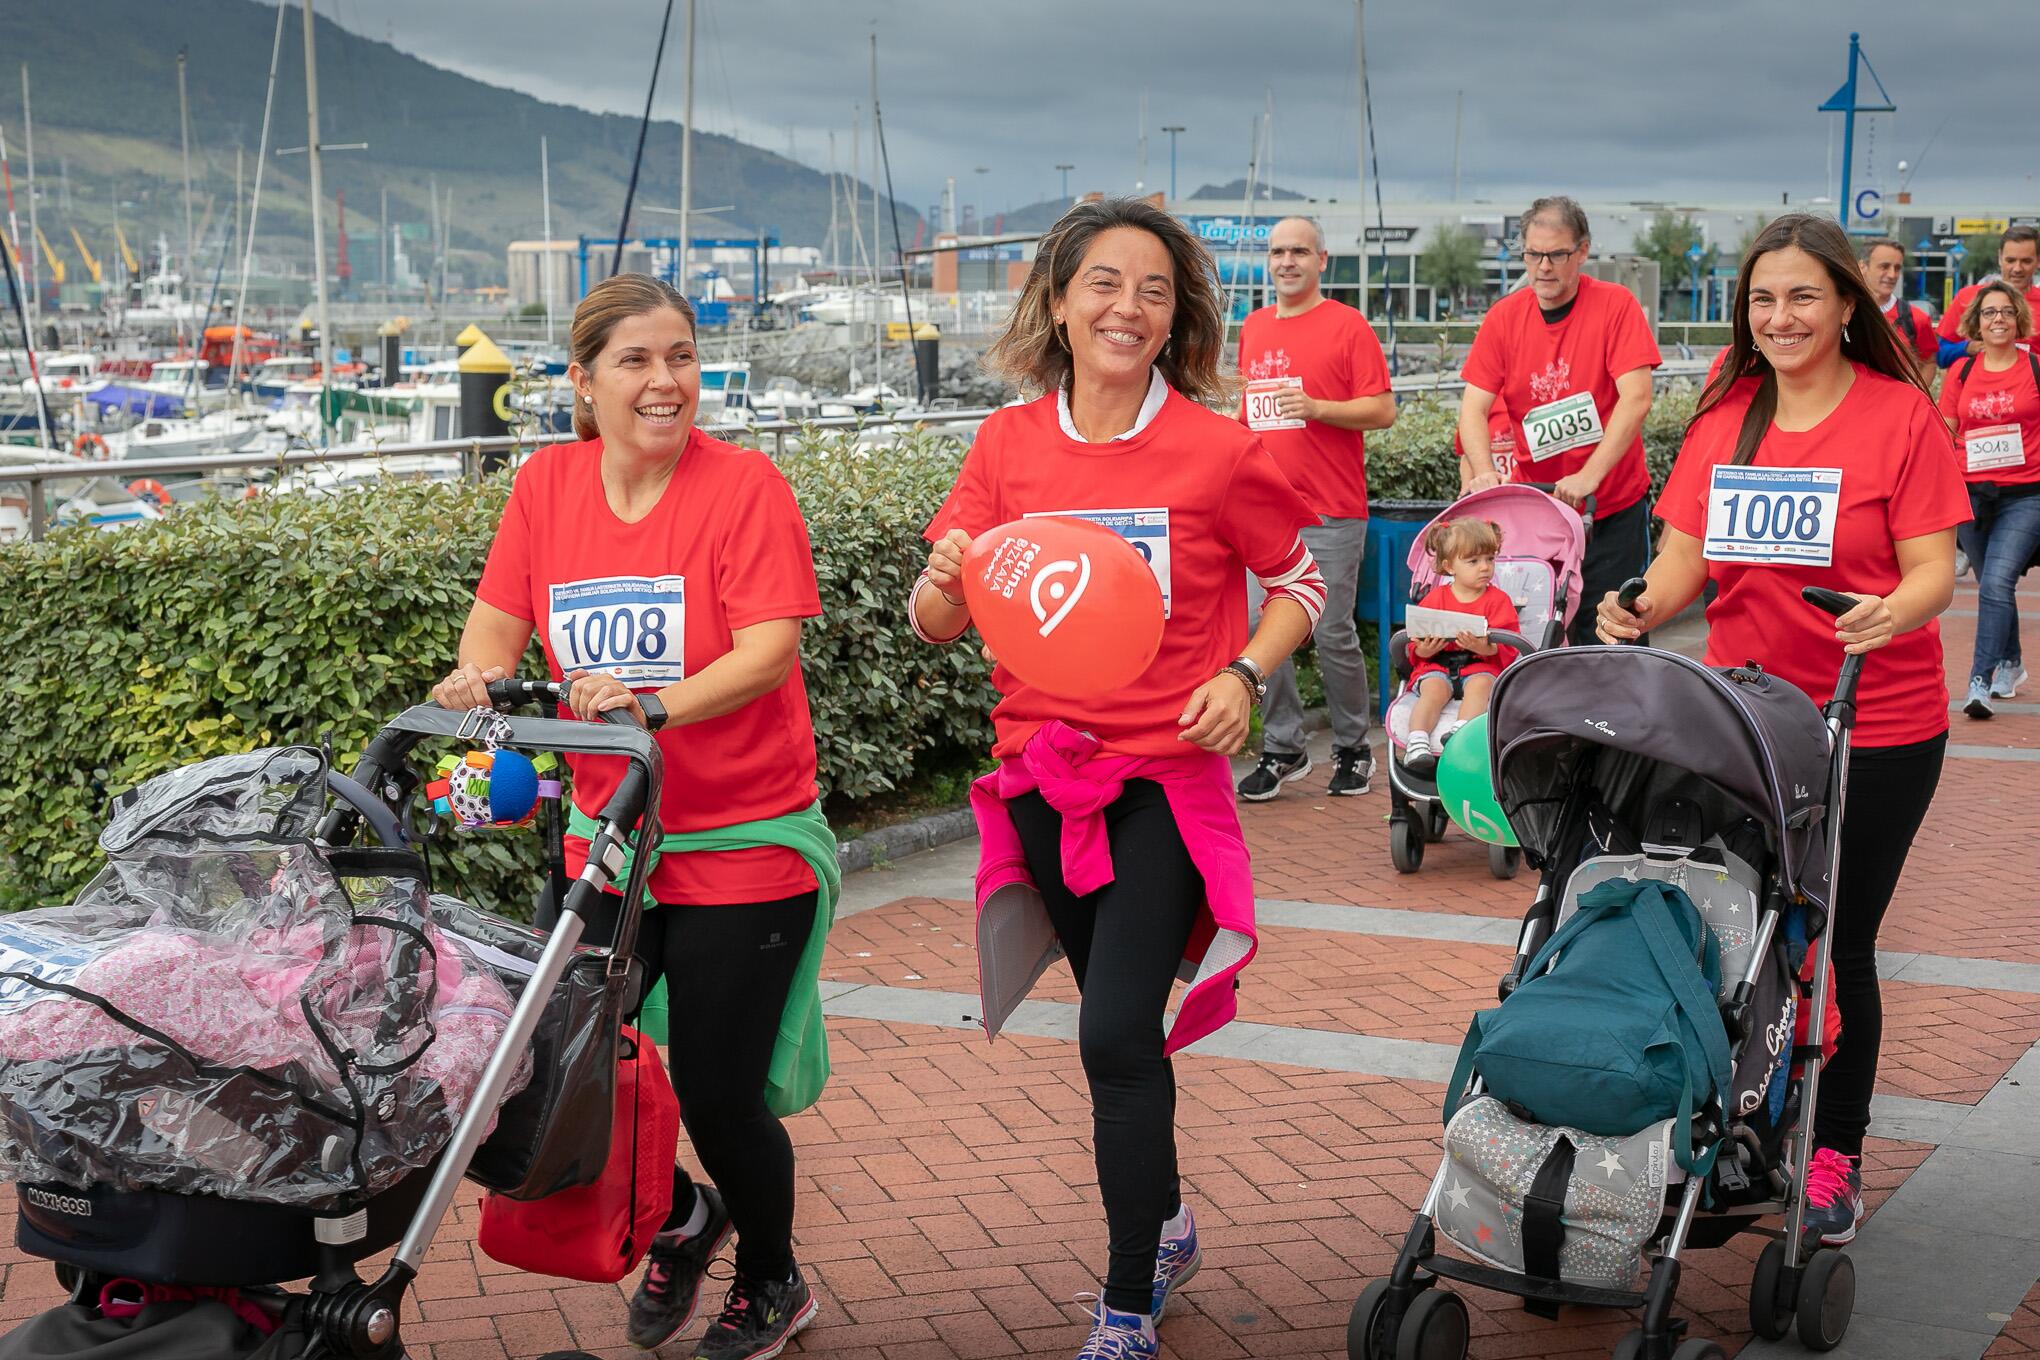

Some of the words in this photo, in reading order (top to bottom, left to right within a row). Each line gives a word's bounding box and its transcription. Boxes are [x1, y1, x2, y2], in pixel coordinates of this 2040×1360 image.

[1855, 189, 1880, 219] C
[1533, 408, 1593, 447] 2035
[1973, 440, 2010, 454] 3018
[1723, 493, 1822, 541] 1008
[990, 537, 1029, 591] BIZKAIA
[1001, 543, 1041, 599] retina
[562, 607, 667, 664] 1008
[27, 1186, 92, 1217] MAXI-COSI
